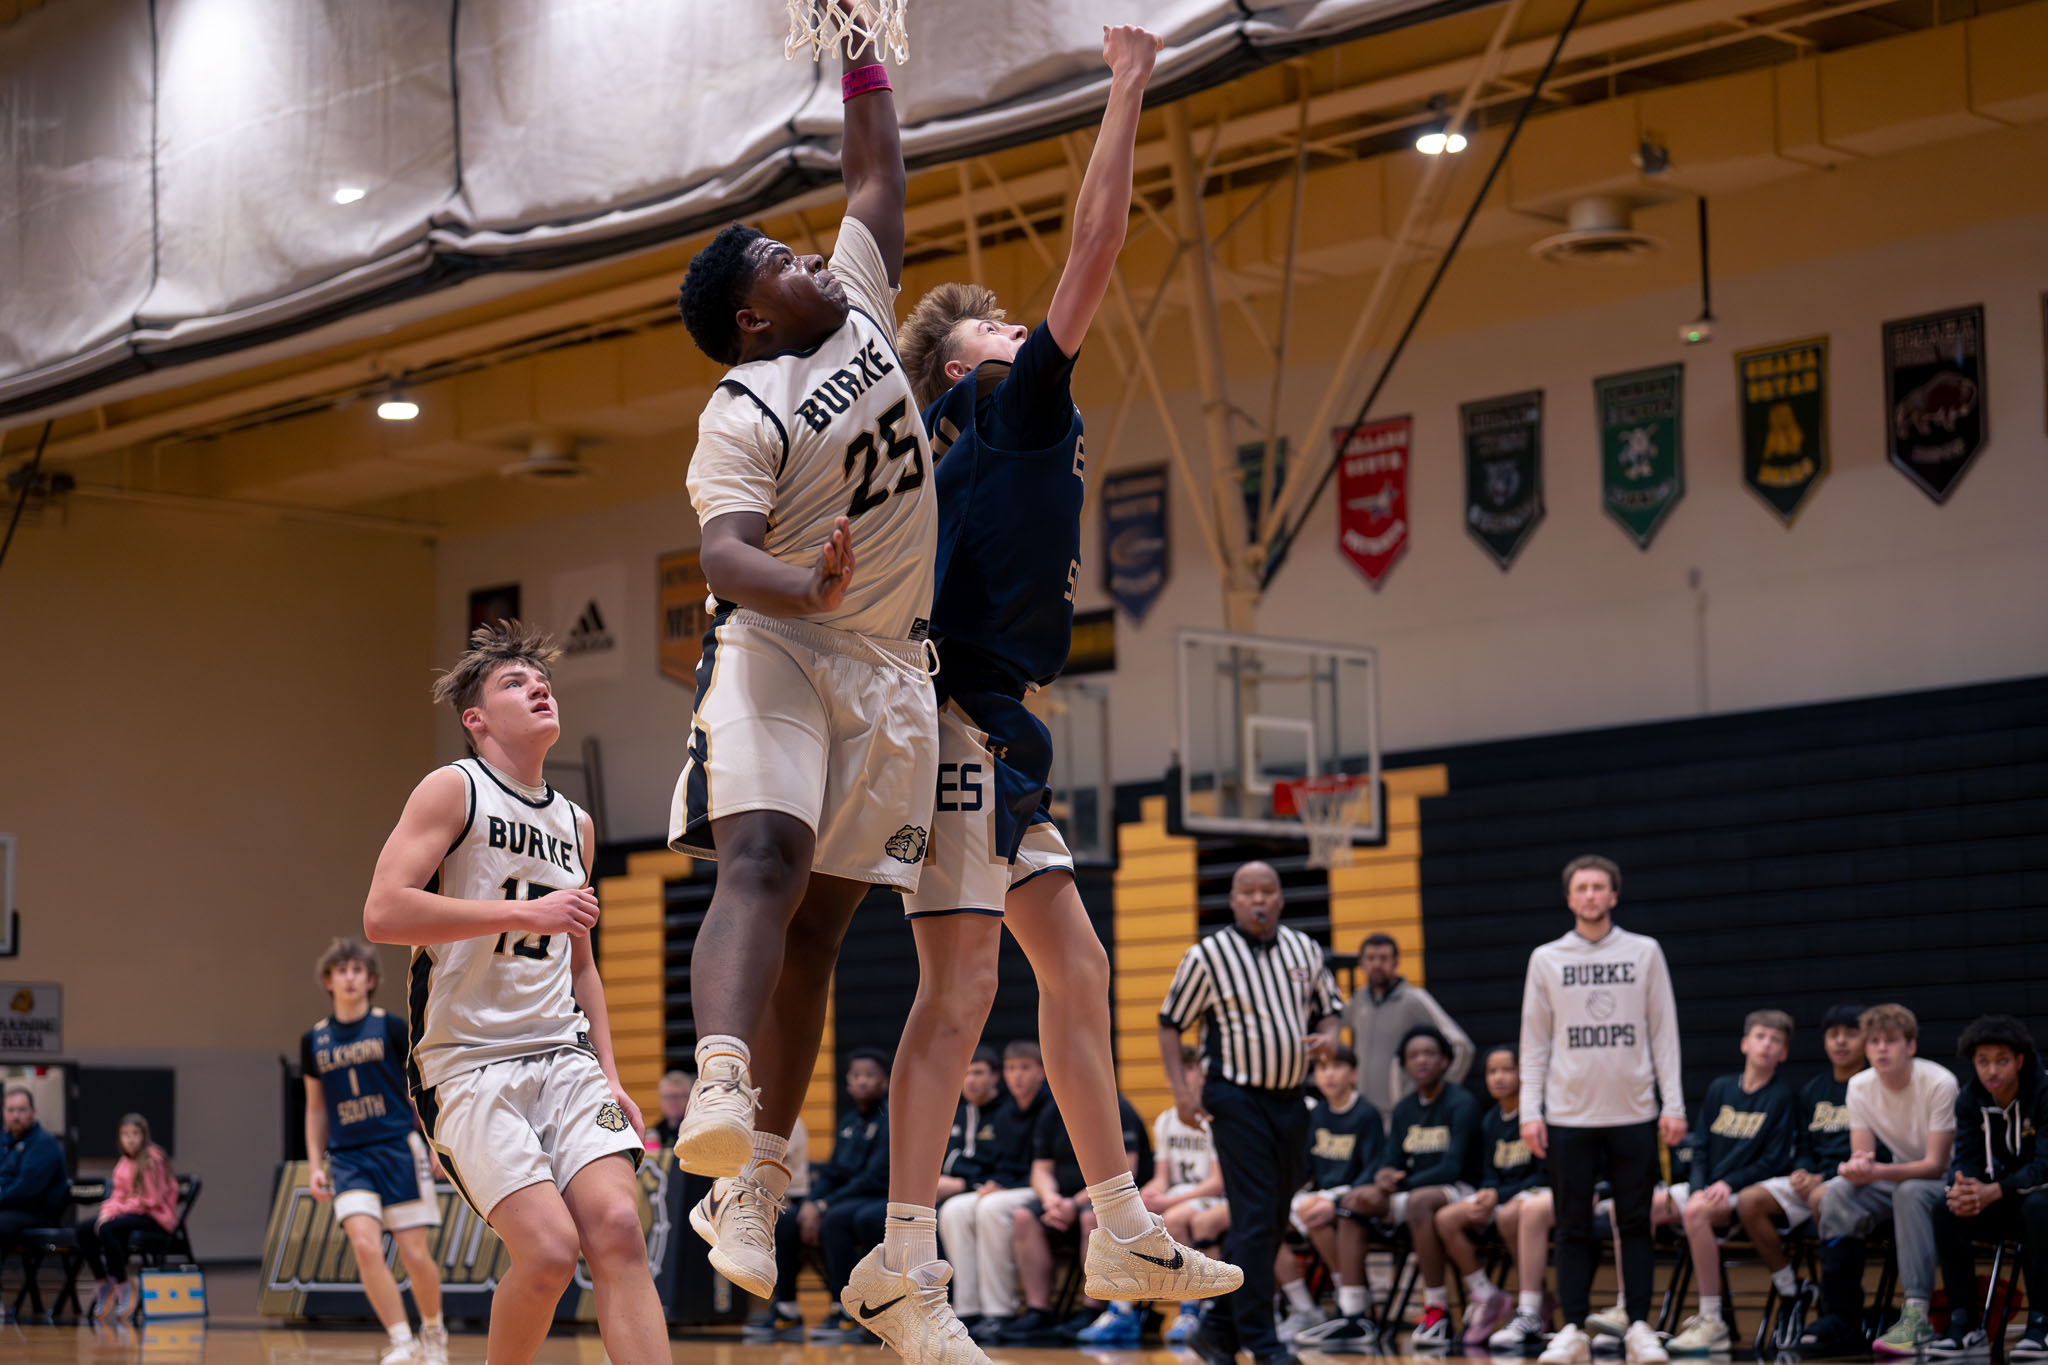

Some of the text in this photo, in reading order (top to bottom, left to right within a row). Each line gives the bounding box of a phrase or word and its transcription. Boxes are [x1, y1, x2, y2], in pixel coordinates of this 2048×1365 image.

[794, 338, 895, 435] BURKE
[842, 395, 926, 518] 25
[936, 763, 983, 812] ES
[487, 815, 574, 874] BURKE
[1563, 963, 1636, 986] BURKE
[1567, 1024, 1636, 1049] HOOPS
[316, 1037, 385, 1074] ELKHORN
[348, 1067, 360, 1096] 1
[337, 1093, 387, 1126] SOUTH
